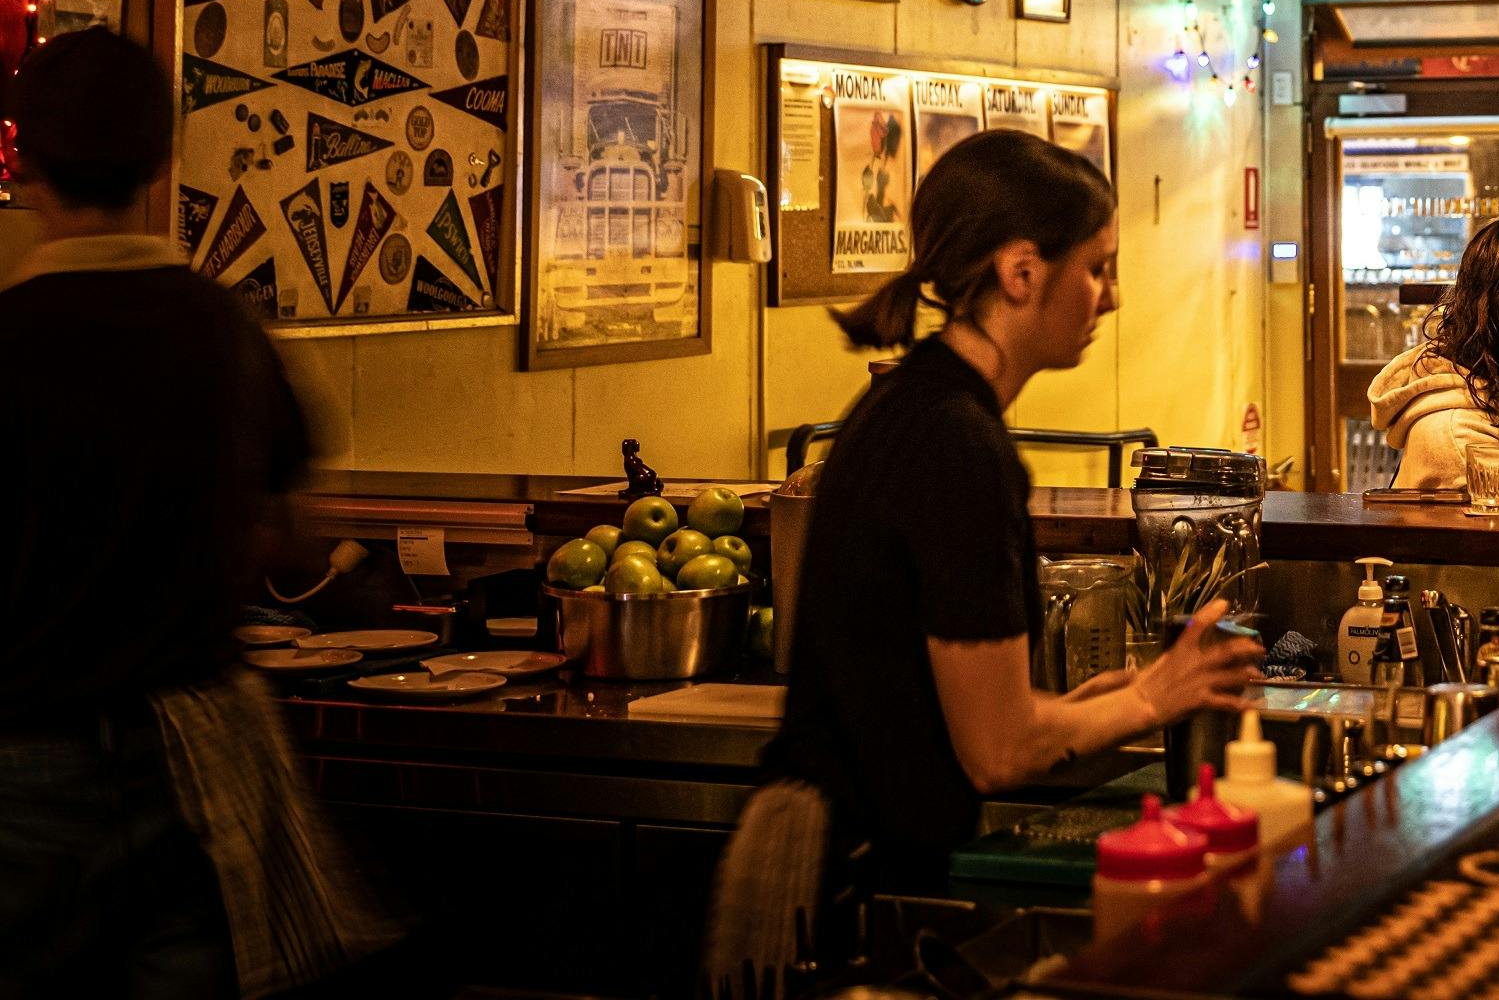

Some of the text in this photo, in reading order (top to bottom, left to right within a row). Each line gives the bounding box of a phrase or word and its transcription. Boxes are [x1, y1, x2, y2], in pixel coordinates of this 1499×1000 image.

[603, 31, 647, 66] TNT
[371, 68, 411, 90] MACLEAN
[835, 74, 887, 102] MONDAY.
[465, 86, 506, 113] COOMA
[914, 79, 964, 109] TUESDAY.
[985, 86, 1037, 115] SATURDAY.
[1051, 91, 1090, 118] SUNDAY.
[217, 203, 258, 262] HARBOUR
[434, 206, 470, 266] IPSWICH
[834, 228, 908, 257] MARGARITAS.
[300, 219, 328, 287] JERSEYVILLE
[1349, 625, 1382, 638] PALMOLIV
